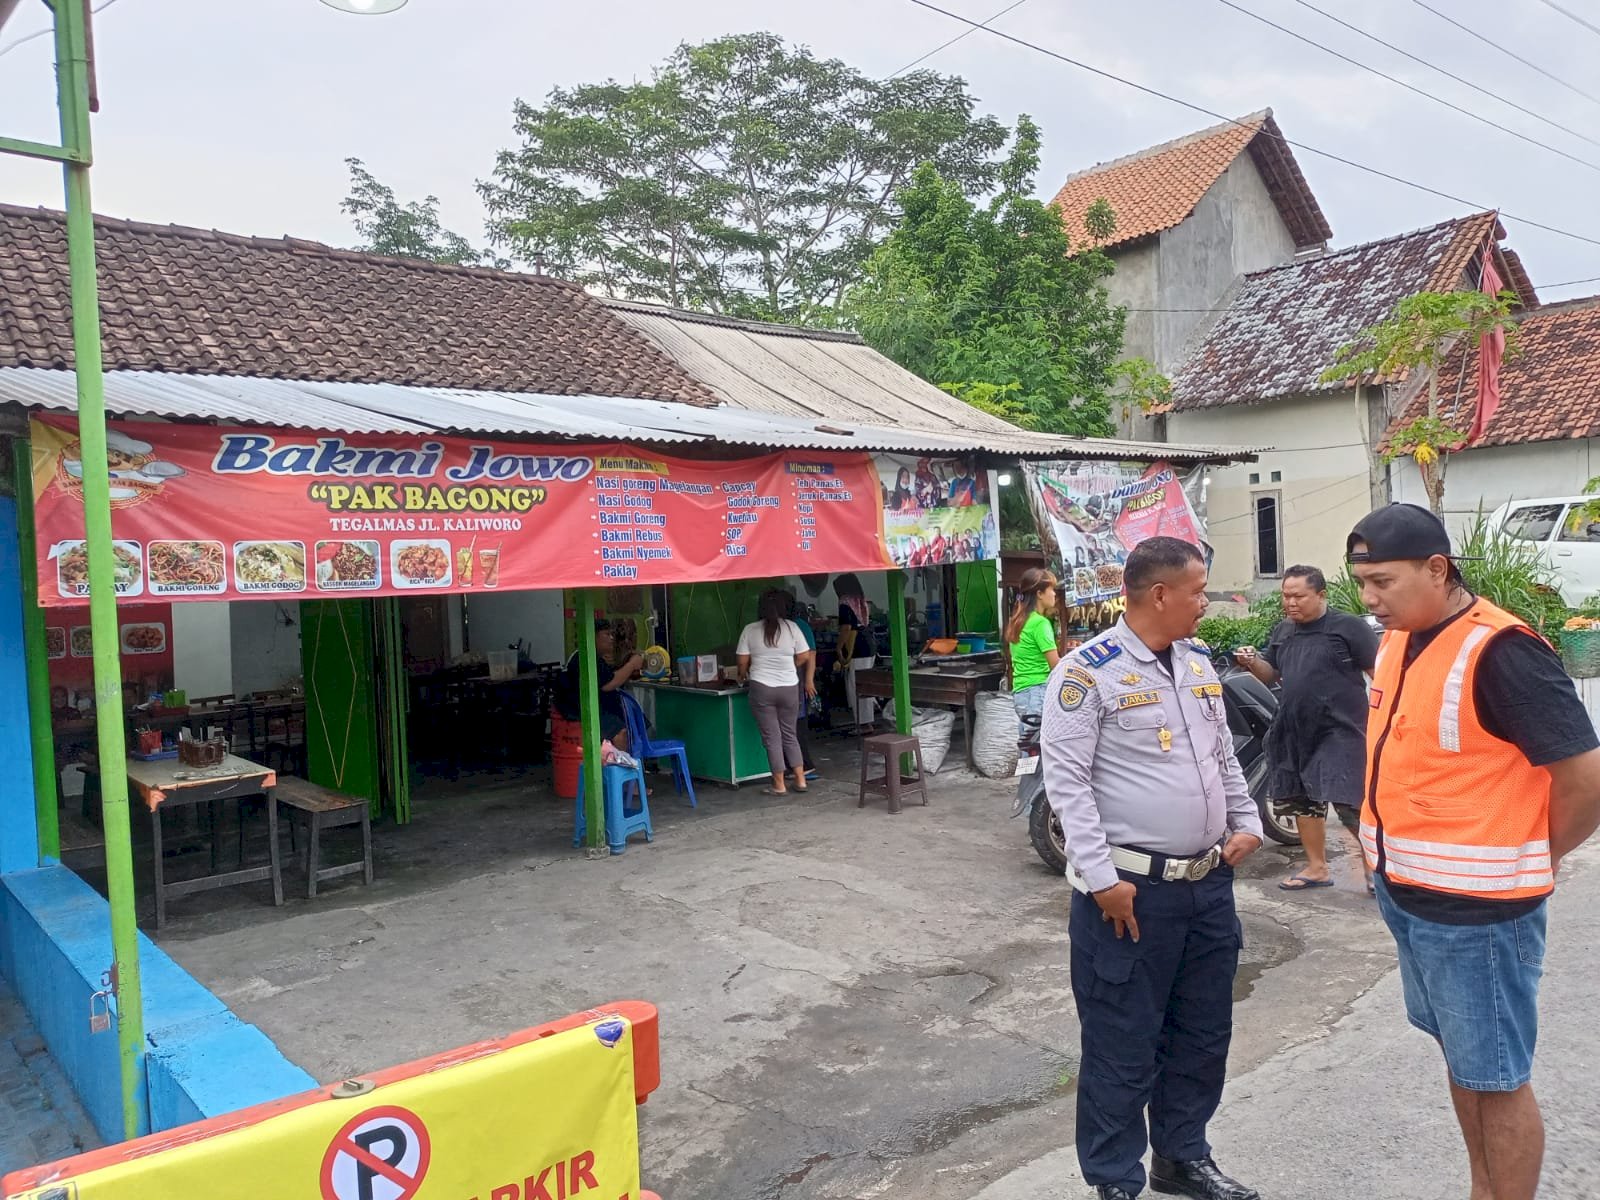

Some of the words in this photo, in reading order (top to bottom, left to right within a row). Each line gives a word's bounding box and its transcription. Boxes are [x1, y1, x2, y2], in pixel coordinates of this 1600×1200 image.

[212, 434, 445, 478] Bakmi
[446, 446, 594, 482] Jowo
[600, 458, 624, 469] Menu
[596, 477, 620, 490] Nasi
[622, 479, 656, 494] goreng
[722, 481, 757, 494] Capcay
[598, 494, 621, 507] Nasi
[624, 495, 652, 509] Godog
[330, 518, 415, 532] TEGALMAS
[419, 518, 440, 532] JL.
[444, 518, 522, 532] KALIWORO
[600, 512, 631, 525] Bakmi
[634, 513, 666, 527] Goreng
[601, 530, 633, 542] Bakmi
[635, 530, 663, 542] Rebus
[726, 529, 742, 541] SOP
[602, 547, 635, 560] Bakmi
[636, 547, 673, 562] Nyemek
[725, 545, 748, 557] Rica
[603, 564, 638, 579] Paklay
[158, 584, 185, 593] BAKMI
[187, 583, 221, 592] GORENG
[244, 582, 270, 590] BAKMI
[1121, 693, 1148, 706] JAKA
